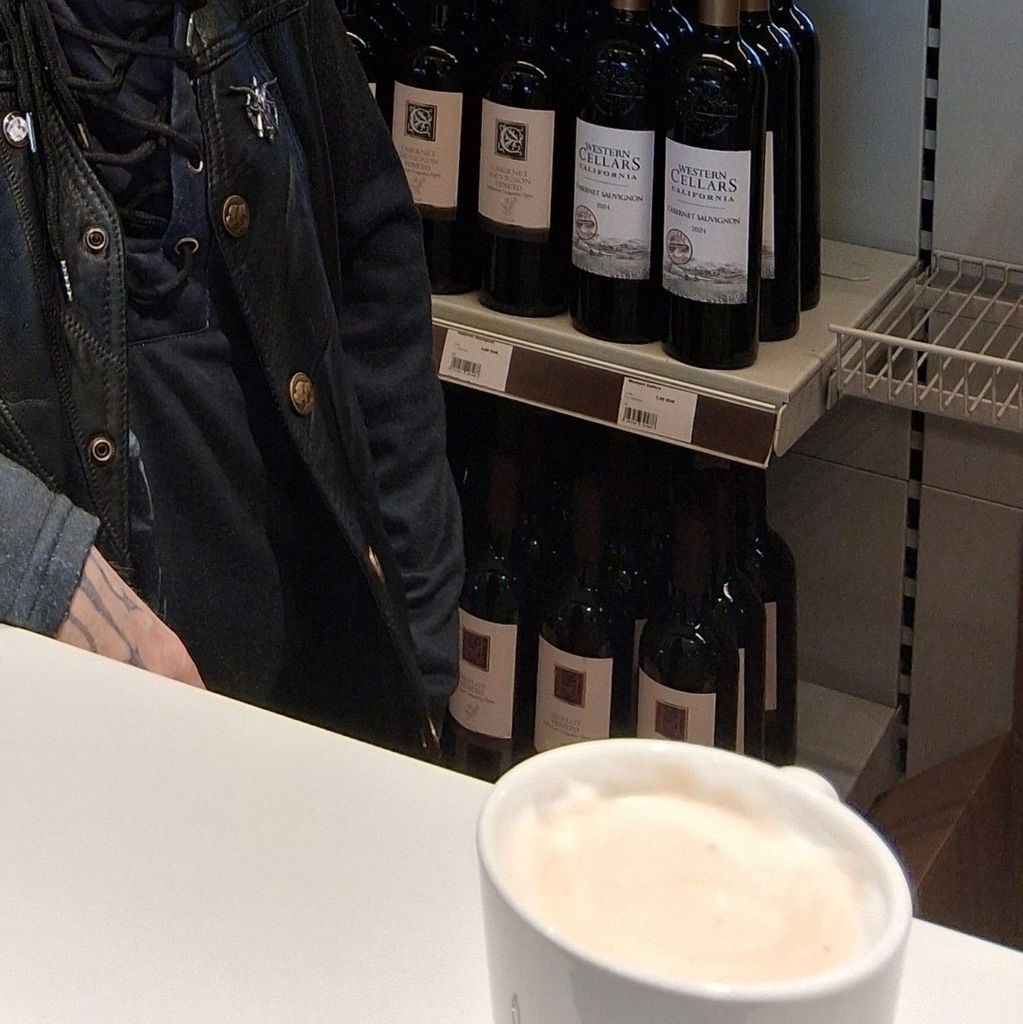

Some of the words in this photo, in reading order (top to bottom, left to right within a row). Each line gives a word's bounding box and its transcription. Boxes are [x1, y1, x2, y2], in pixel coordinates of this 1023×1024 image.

[584, 142, 631, 158] WESTERN
[579, 147, 641, 171] CELLARS
[579, 163, 638, 180] CALIFORNIA
[678, 163, 727, 180] WESTERN
[670, 168, 738, 193] CELLARS
[601, 190, 644, 202] SAUVIGNON
[671, 185, 735, 202] CALIFORNIA
[667, 204, 695, 219] CABERNET
[696, 213, 741, 225] SAUVIGNON
[691, 225, 707, 234] 2024
